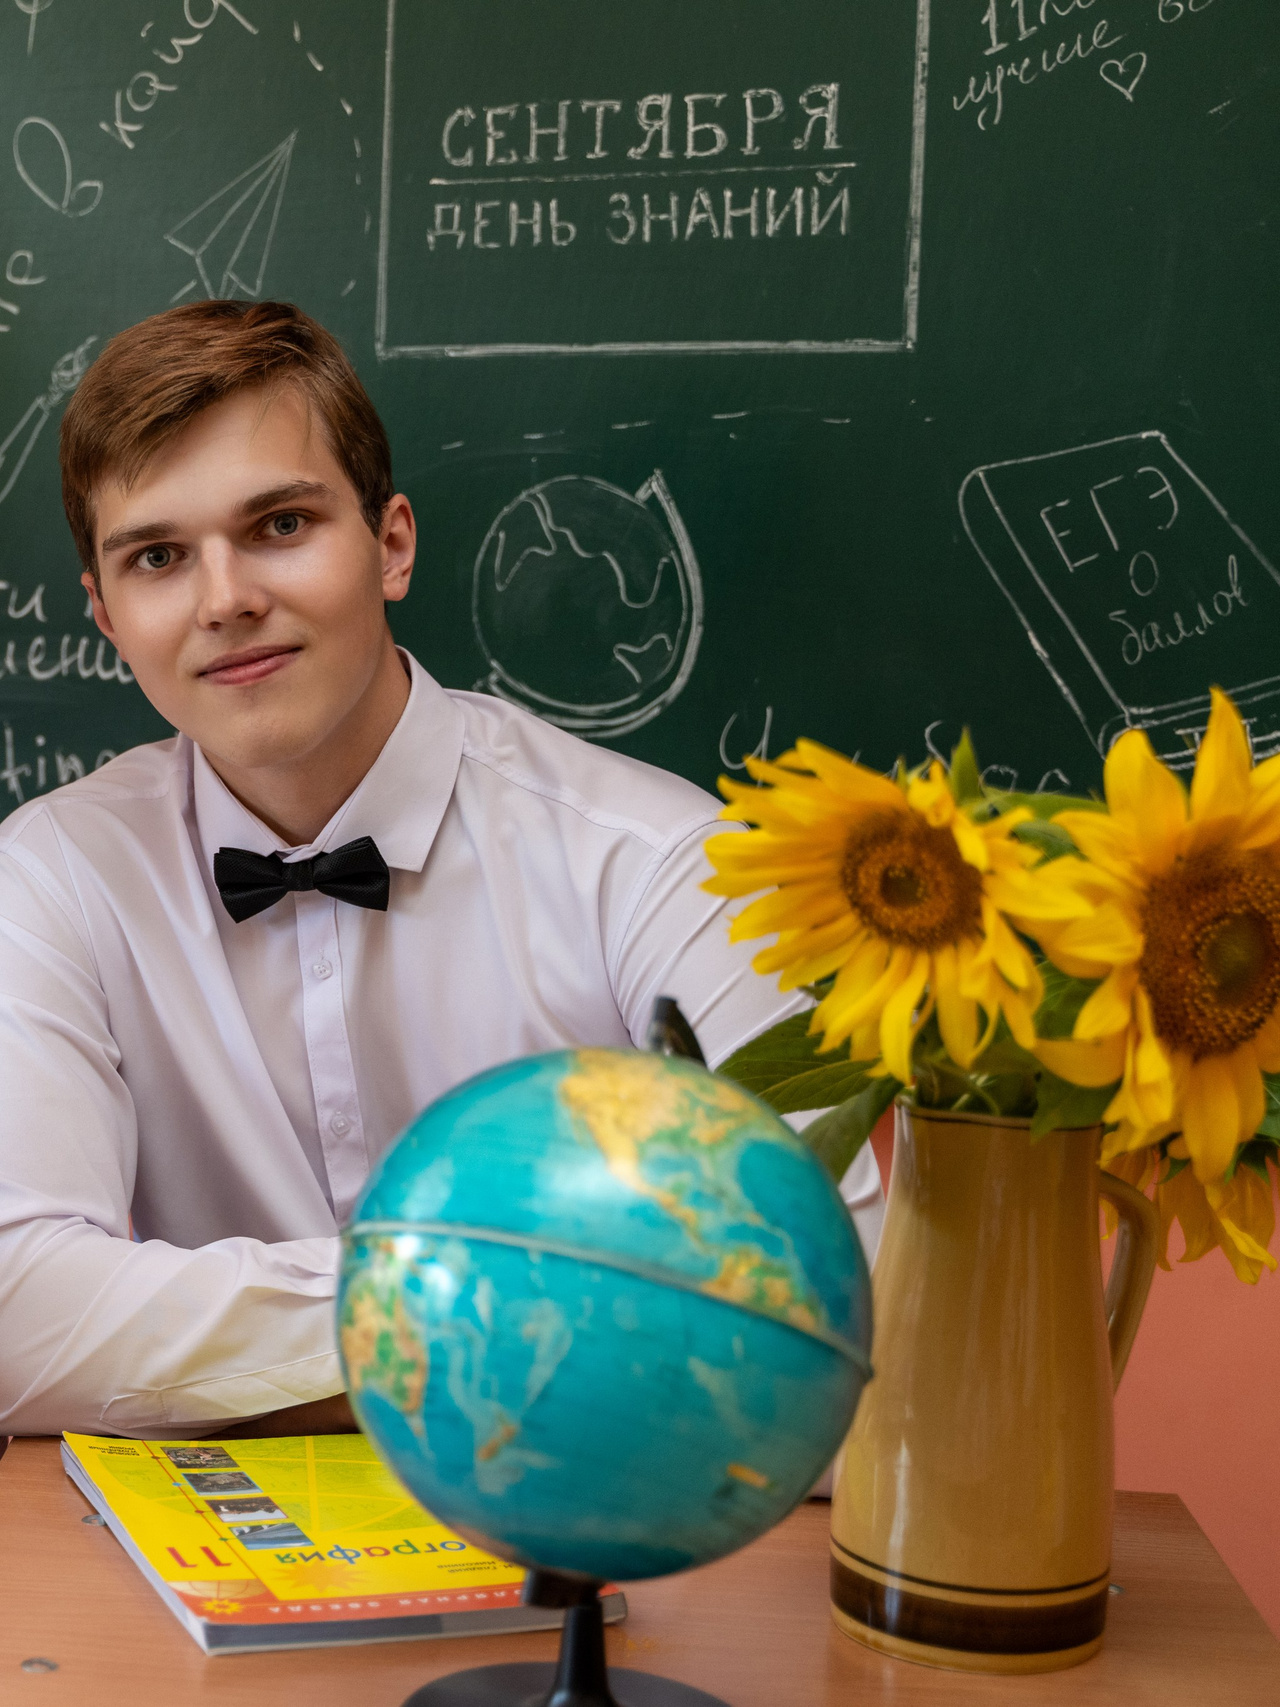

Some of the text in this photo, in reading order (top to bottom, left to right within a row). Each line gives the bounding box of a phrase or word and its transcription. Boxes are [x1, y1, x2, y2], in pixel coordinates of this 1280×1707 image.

[441, 83, 842, 167] СЕНТЯБРЯ
[426, 170, 851, 250] ДЕНЬ ЗНАНИЙ
[1041, 466, 1178, 572] ЕГЭ
[1108, 554, 1250, 665] баллов
[165, 1545, 233, 1569] 11
[273, 1538, 467, 1566] ография
